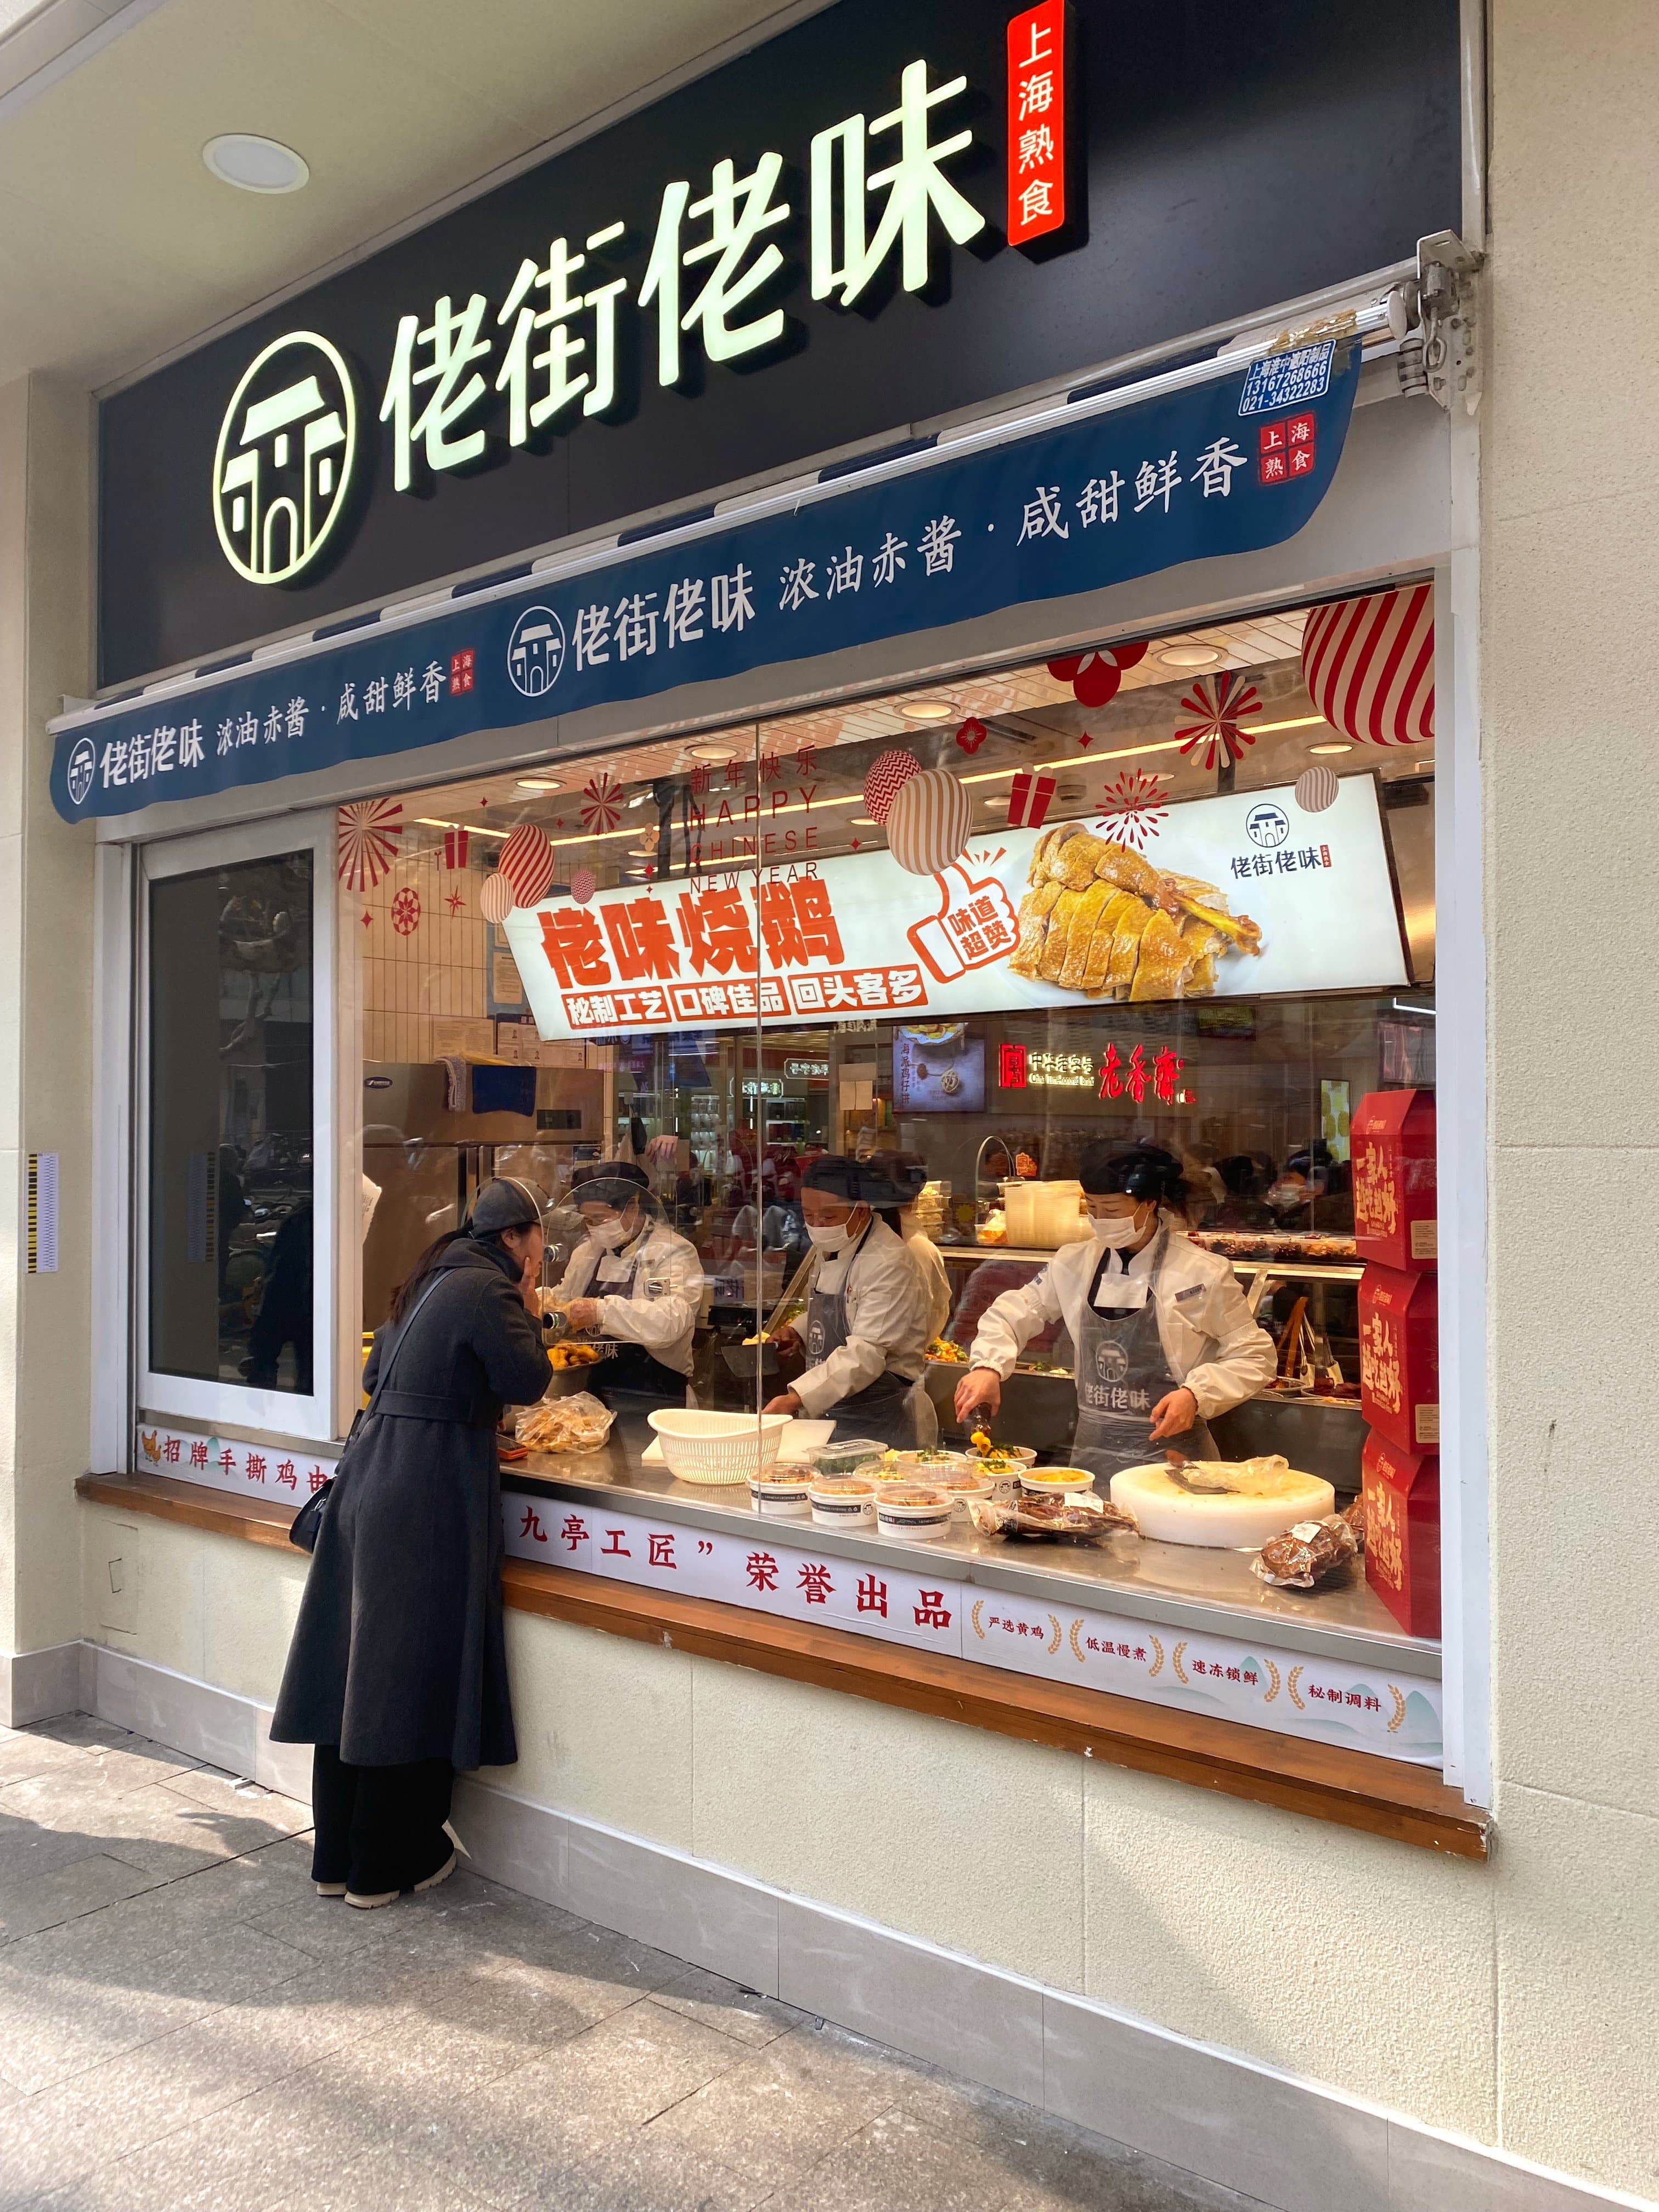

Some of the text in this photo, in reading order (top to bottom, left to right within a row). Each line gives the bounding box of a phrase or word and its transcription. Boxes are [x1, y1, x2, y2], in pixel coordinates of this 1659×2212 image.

[1017, 22, 1056, 225] 上海熟食
[380, 59, 985, 492] 佬街佬味
[1242, 376, 1325, 412] 021-34322283
[1247, 361, 1328, 396] 13167268666
[1262, 422, 1311, 450] 上海
[1265, 450, 1311, 478] 熟食
[572, 563, 756, 672] 佬街佬味
[99, 718, 205, 788] 佬街佬味
[690, 744, 817, 795] 新年快乐
[690, 785, 817, 832] HAPPY
[690, 827, 817, 865] CHINESE
[1231, 847, 1322, 879] 佬街佬味
[690, 862, 818, 894] NEW YEAR
[537, 877, 845, 989] 佬味烧鹅
[949, 896, 998, 934] 味道
[960, 918, 1014, 961] 超赞
[567, 971, 924, 1026] 秘制工艺 口碑佳品 回头客多
[1029, 1052, 1094, 1075] 中华老字号
[988, 1616, 1045, 1640] 严选黄鸡
[1085, 1636, 1147, 1662] 低温慢煮
[1191, 1659, 1259, 1687] 速冻锁鲜
[1308, 1684, 1381, 1713] 秘制调料
